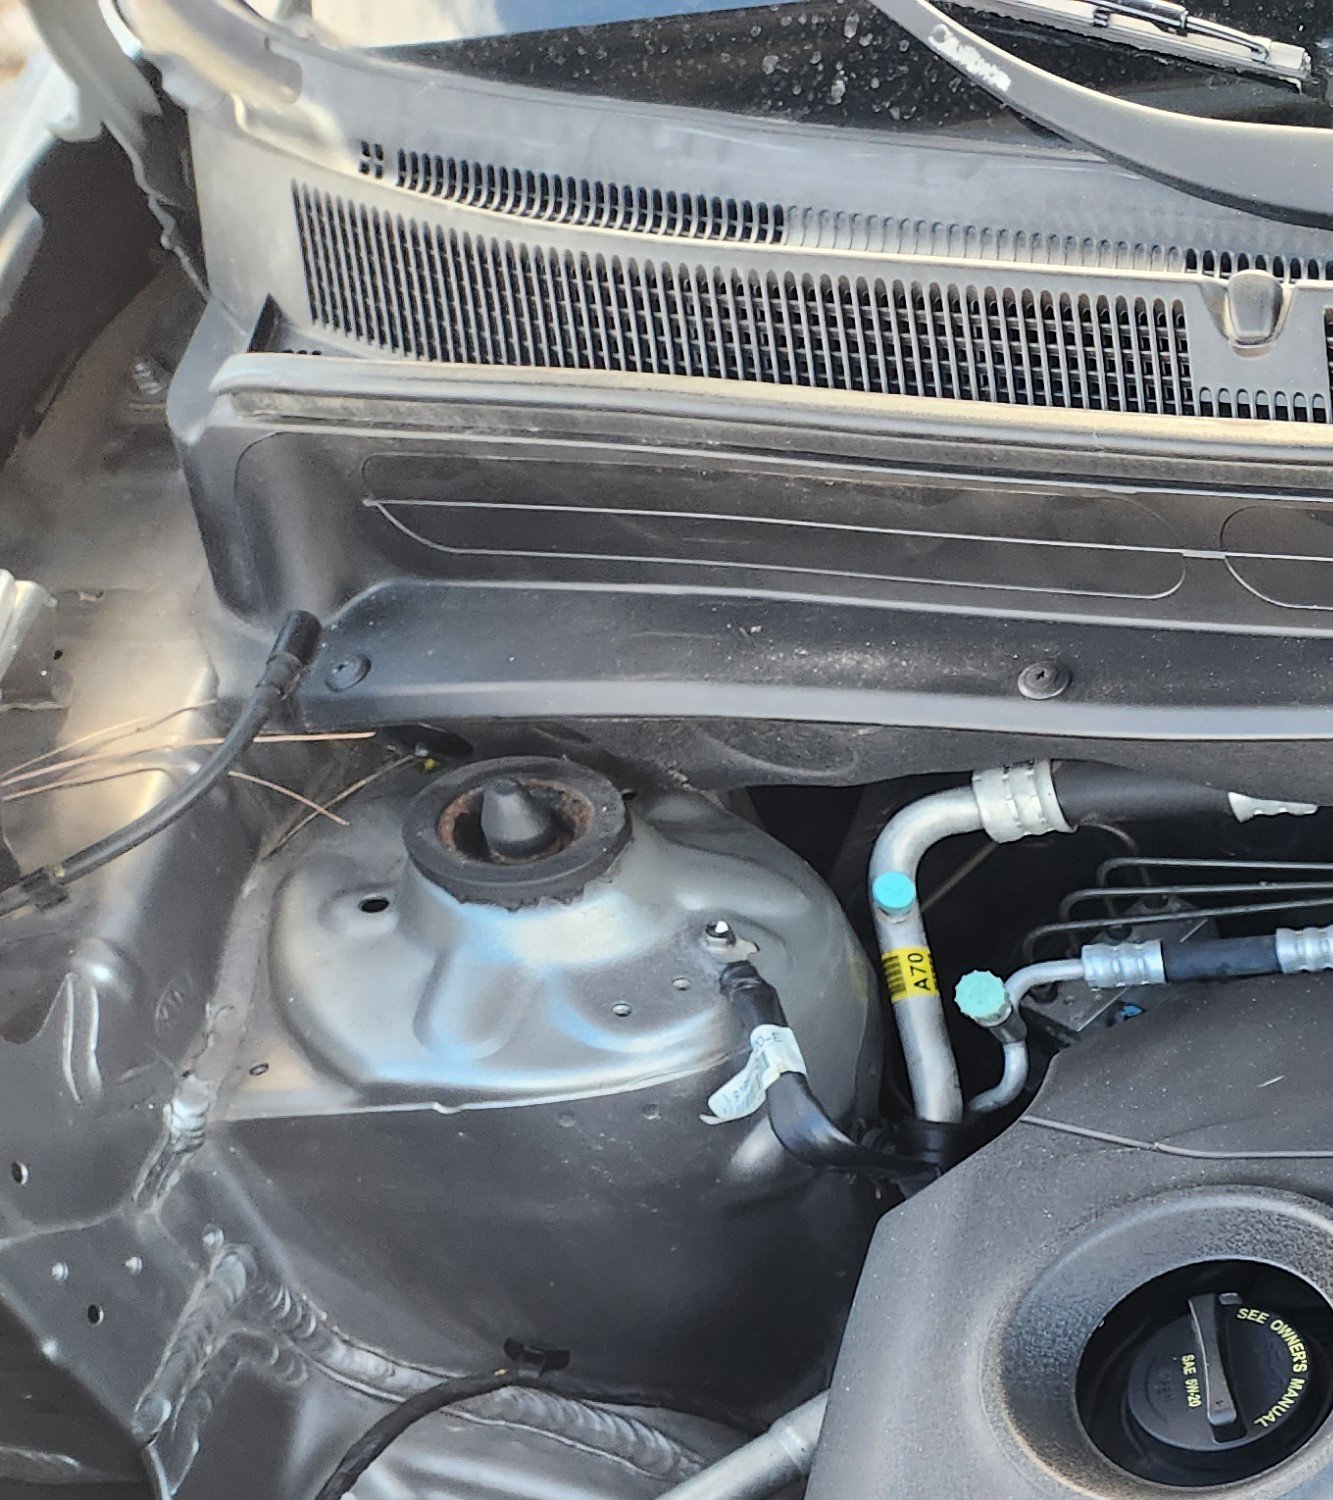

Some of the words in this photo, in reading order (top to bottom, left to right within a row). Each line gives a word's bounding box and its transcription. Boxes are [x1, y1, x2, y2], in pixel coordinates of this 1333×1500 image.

[908, 952, 931, 991] A70
[1237, 1307, 1270, 1325] SEE
[1181, 1354, 1197, 1375] SAE
[1270, 1319, 1308, 1374] OWNER'S
[1254, 1377, 1306, 1428] MANUAL
